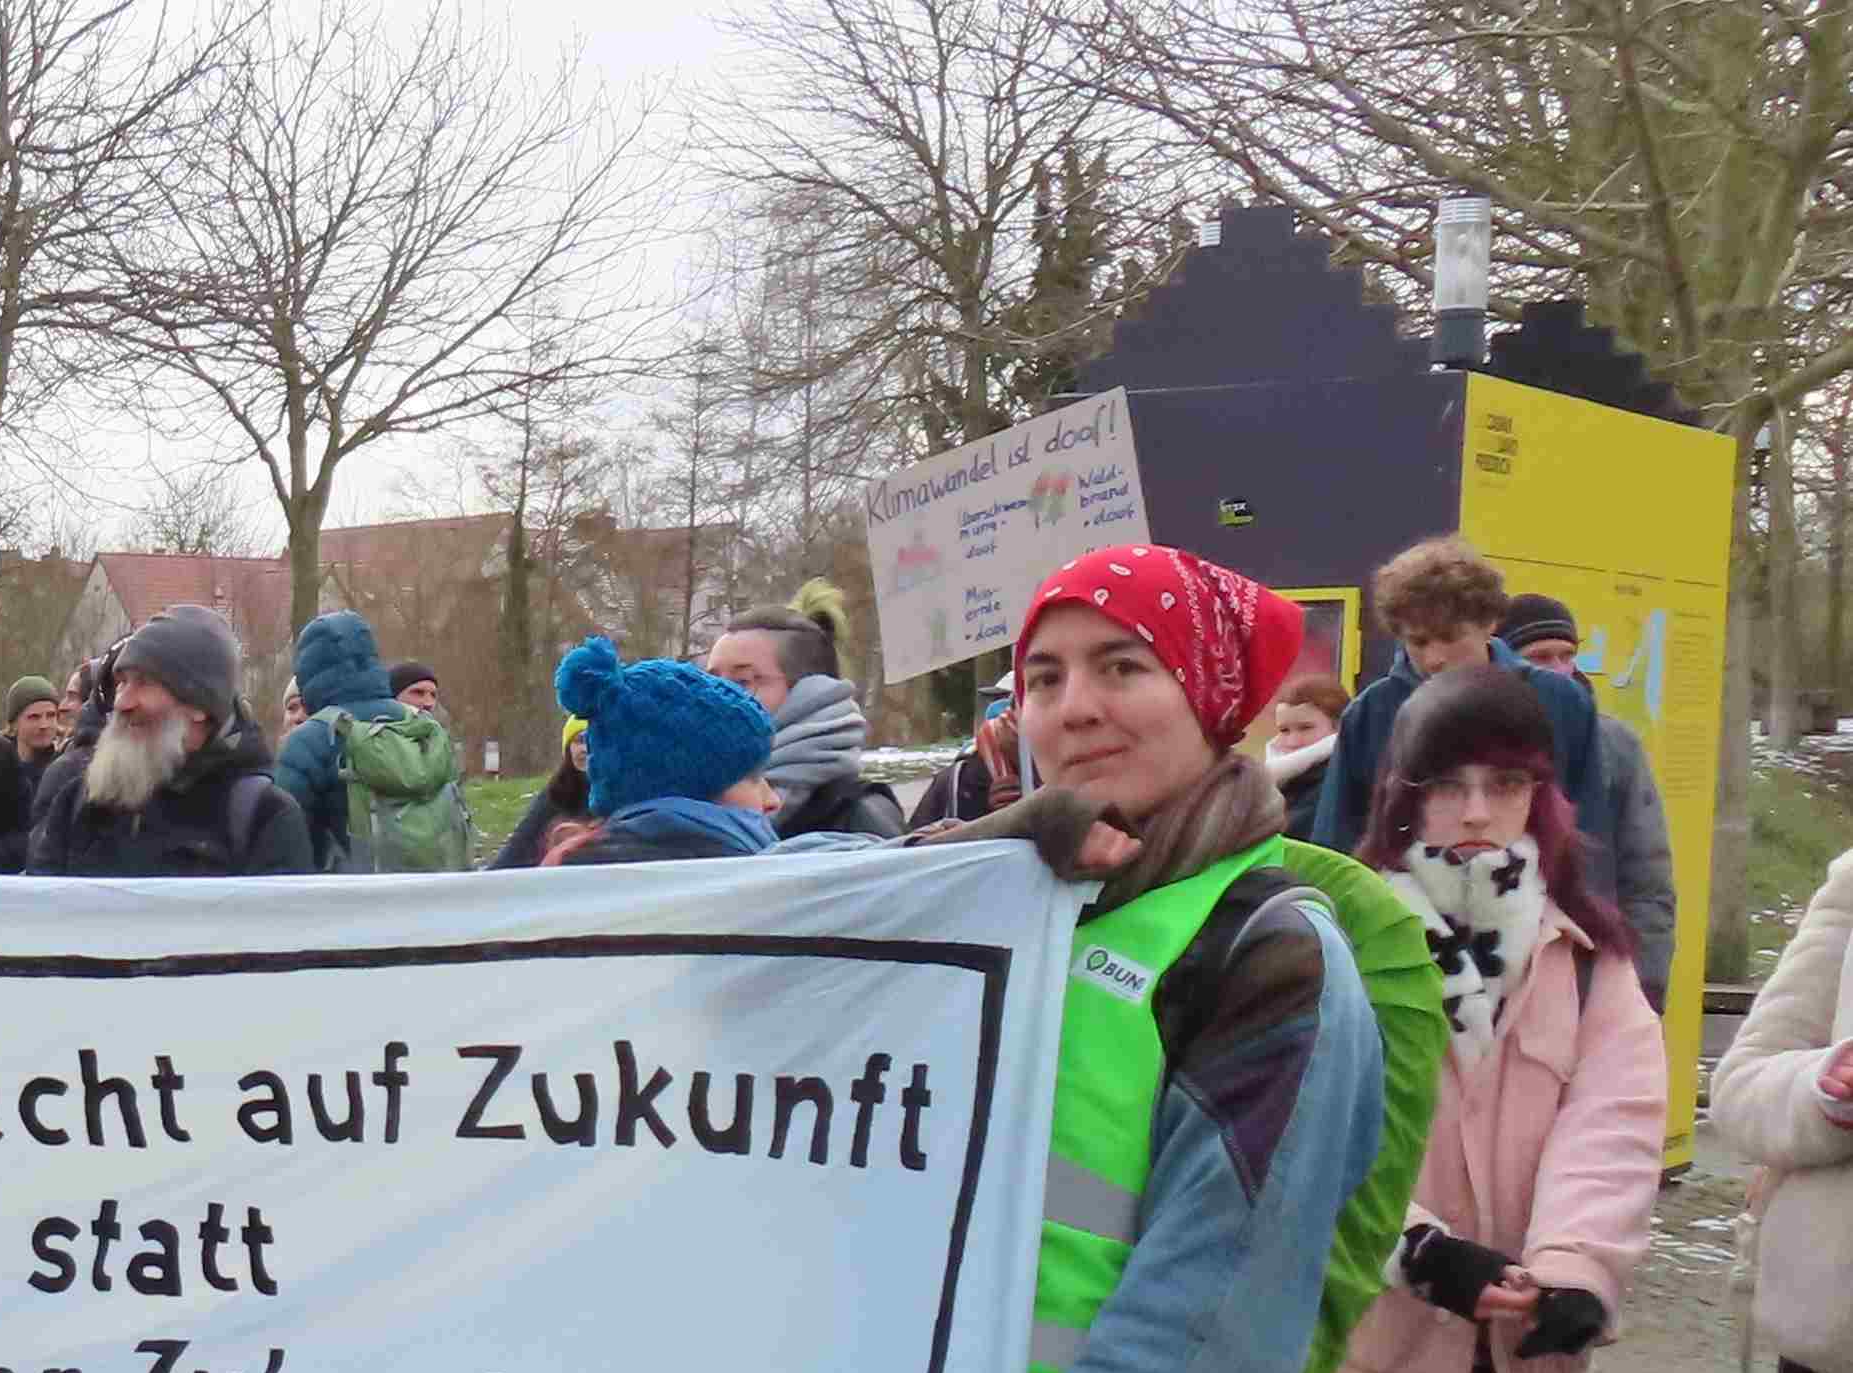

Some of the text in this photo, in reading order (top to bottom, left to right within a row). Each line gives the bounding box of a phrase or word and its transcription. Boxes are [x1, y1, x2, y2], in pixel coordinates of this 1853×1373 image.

[866, 444, 999, 529] Klimawandel
[235, 1040, 410, 1146] auf
[453, 1039, 933, 1173] Zukunft
[26, 1198, 279, 1298] statt
